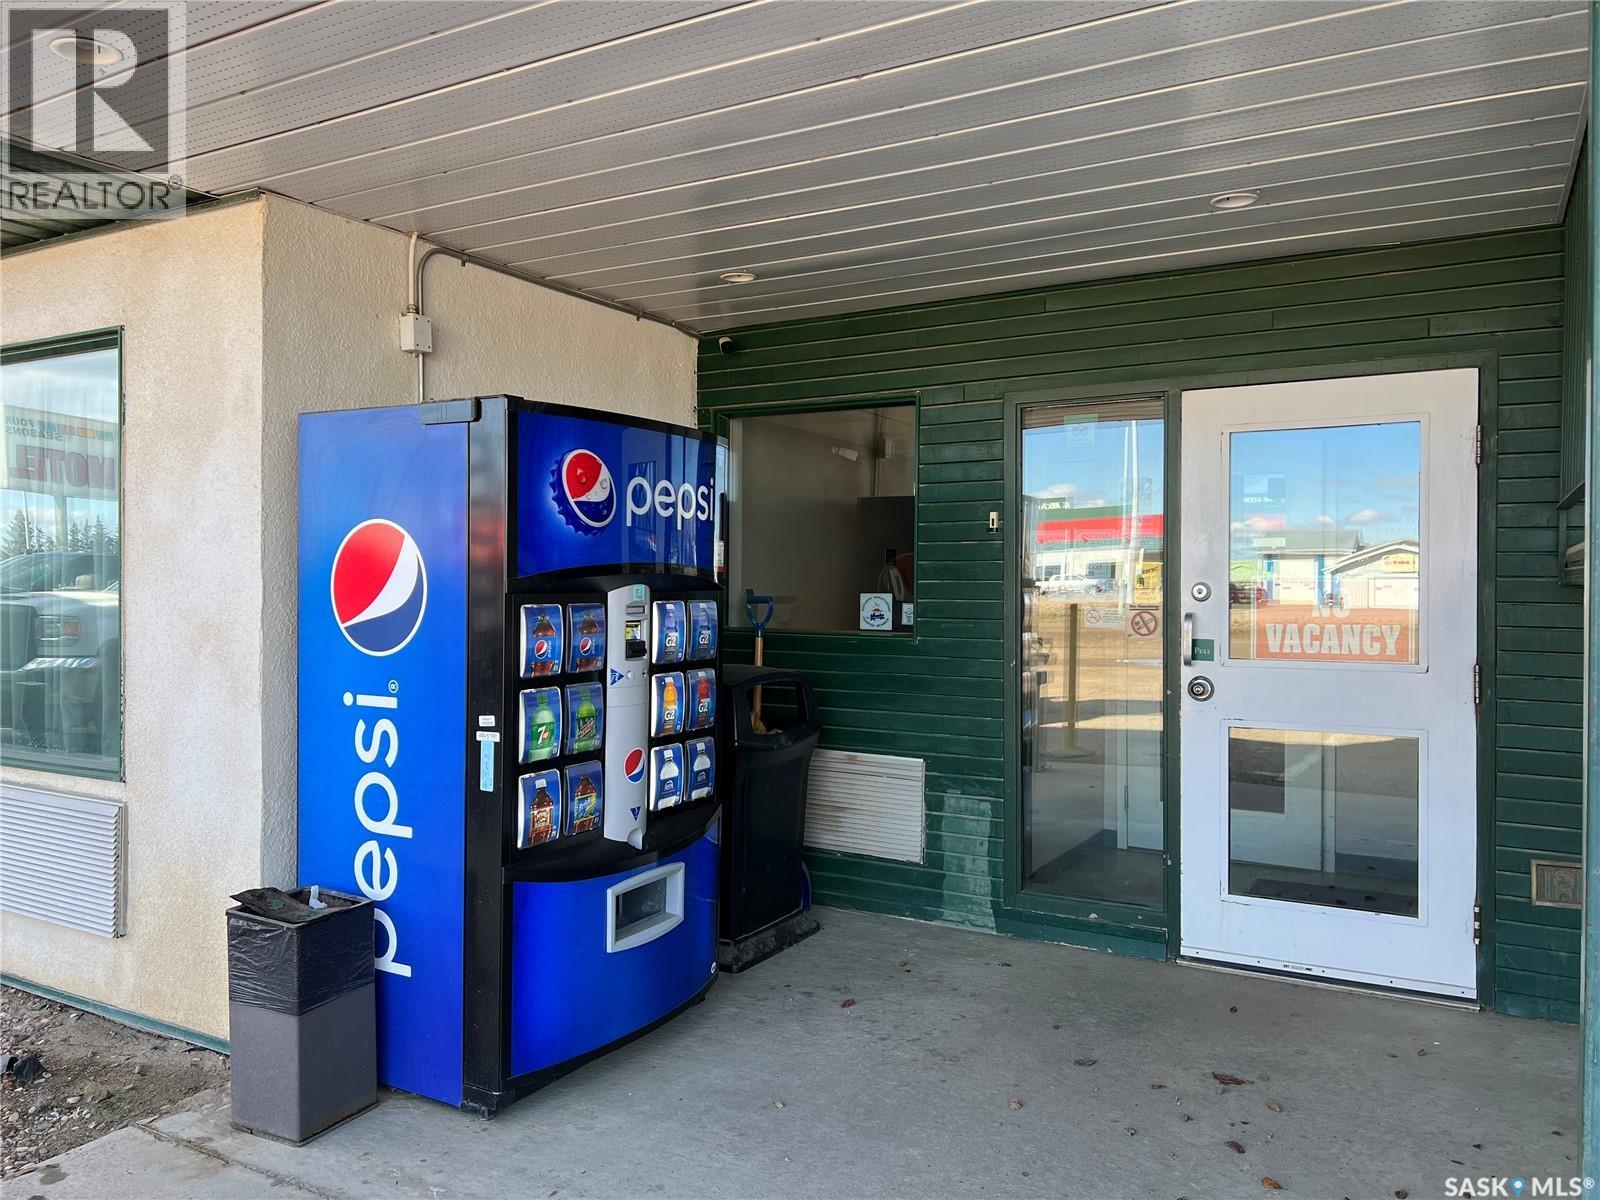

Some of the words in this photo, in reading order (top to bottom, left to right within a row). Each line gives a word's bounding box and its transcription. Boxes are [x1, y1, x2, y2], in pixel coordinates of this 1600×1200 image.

[625, 476, 714, 531] pepsi
[665, 637, 677, 648] G2
[1265, 623, 1402, 656] VACANCY
[1194, 647, 1212, 655] PULL
[698, 702, 708, 713] G2
[664, 710, 675, 721] G2
